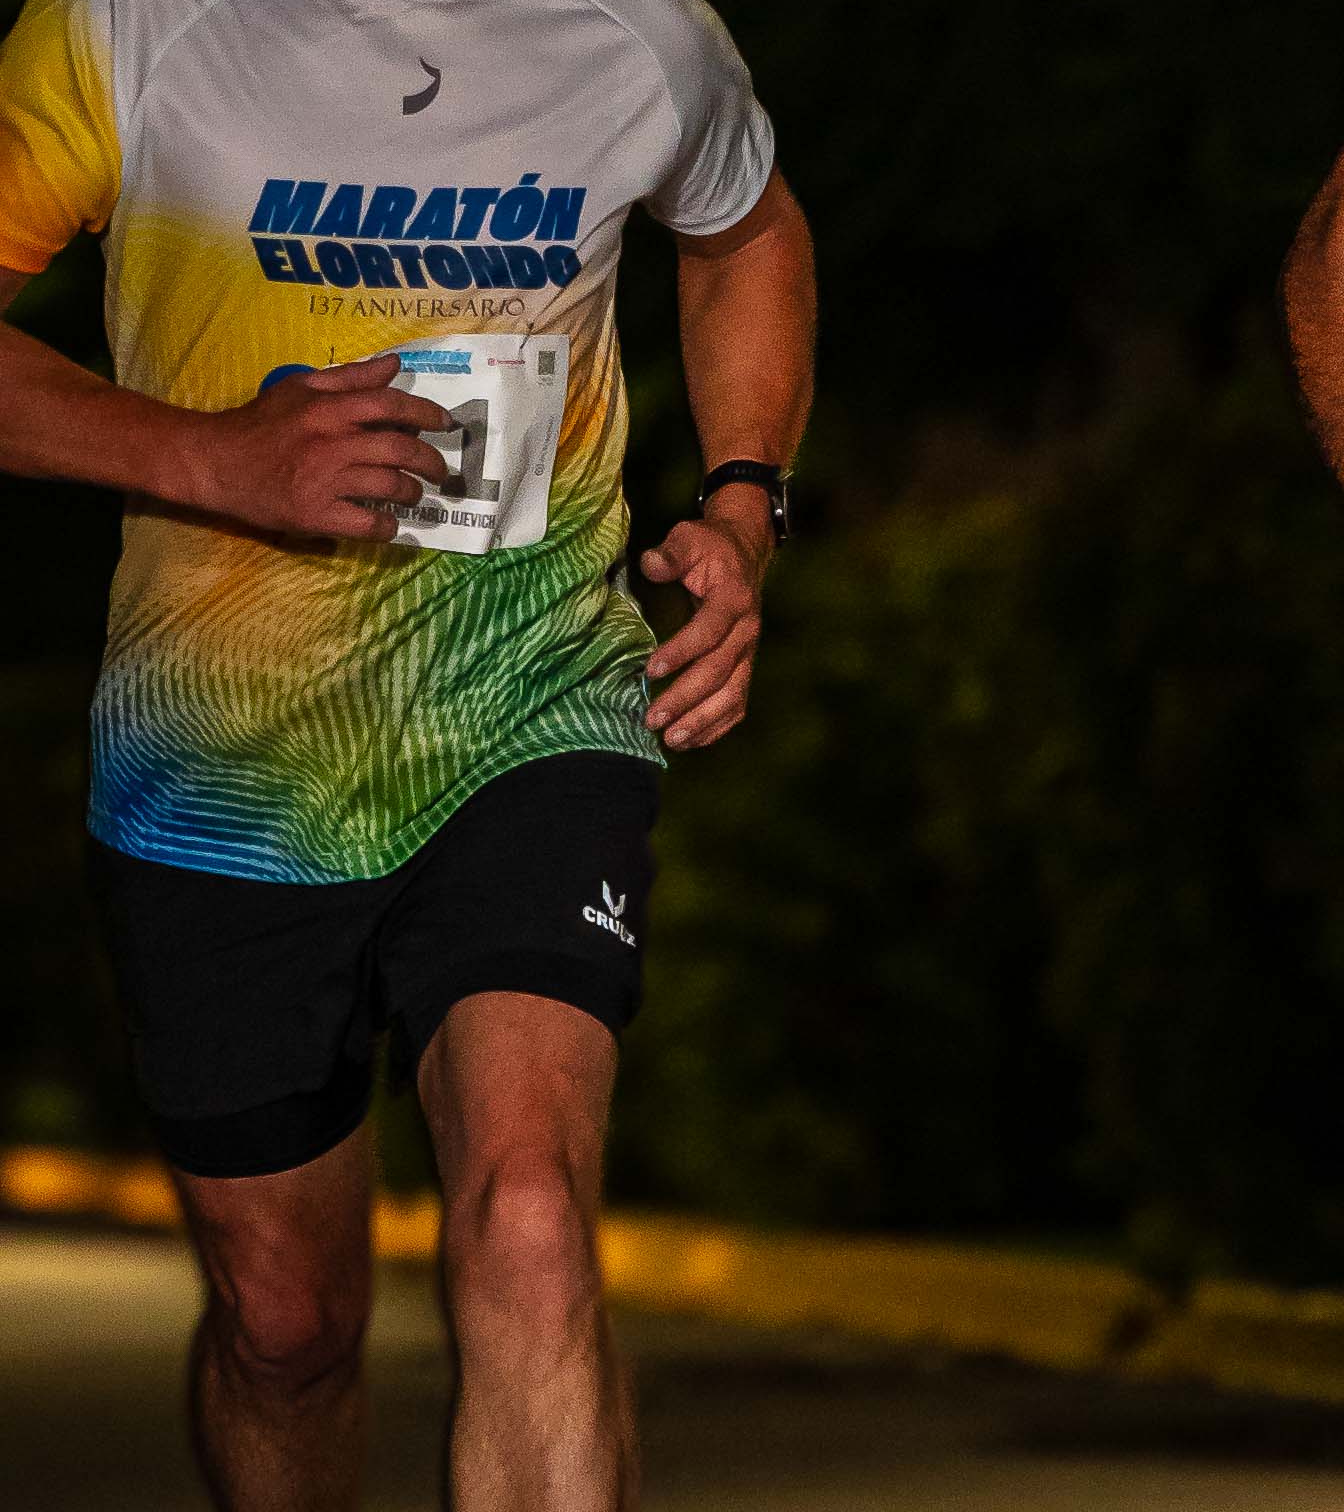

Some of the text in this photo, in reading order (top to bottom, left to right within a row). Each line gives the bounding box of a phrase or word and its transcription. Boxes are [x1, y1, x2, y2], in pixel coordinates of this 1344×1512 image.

[248, 171, 588, 241] MARATÓN
[251, 237, 583, 290] ELORTONDO
[308, 295, 526, 318] 137 ANIVERSARIO
